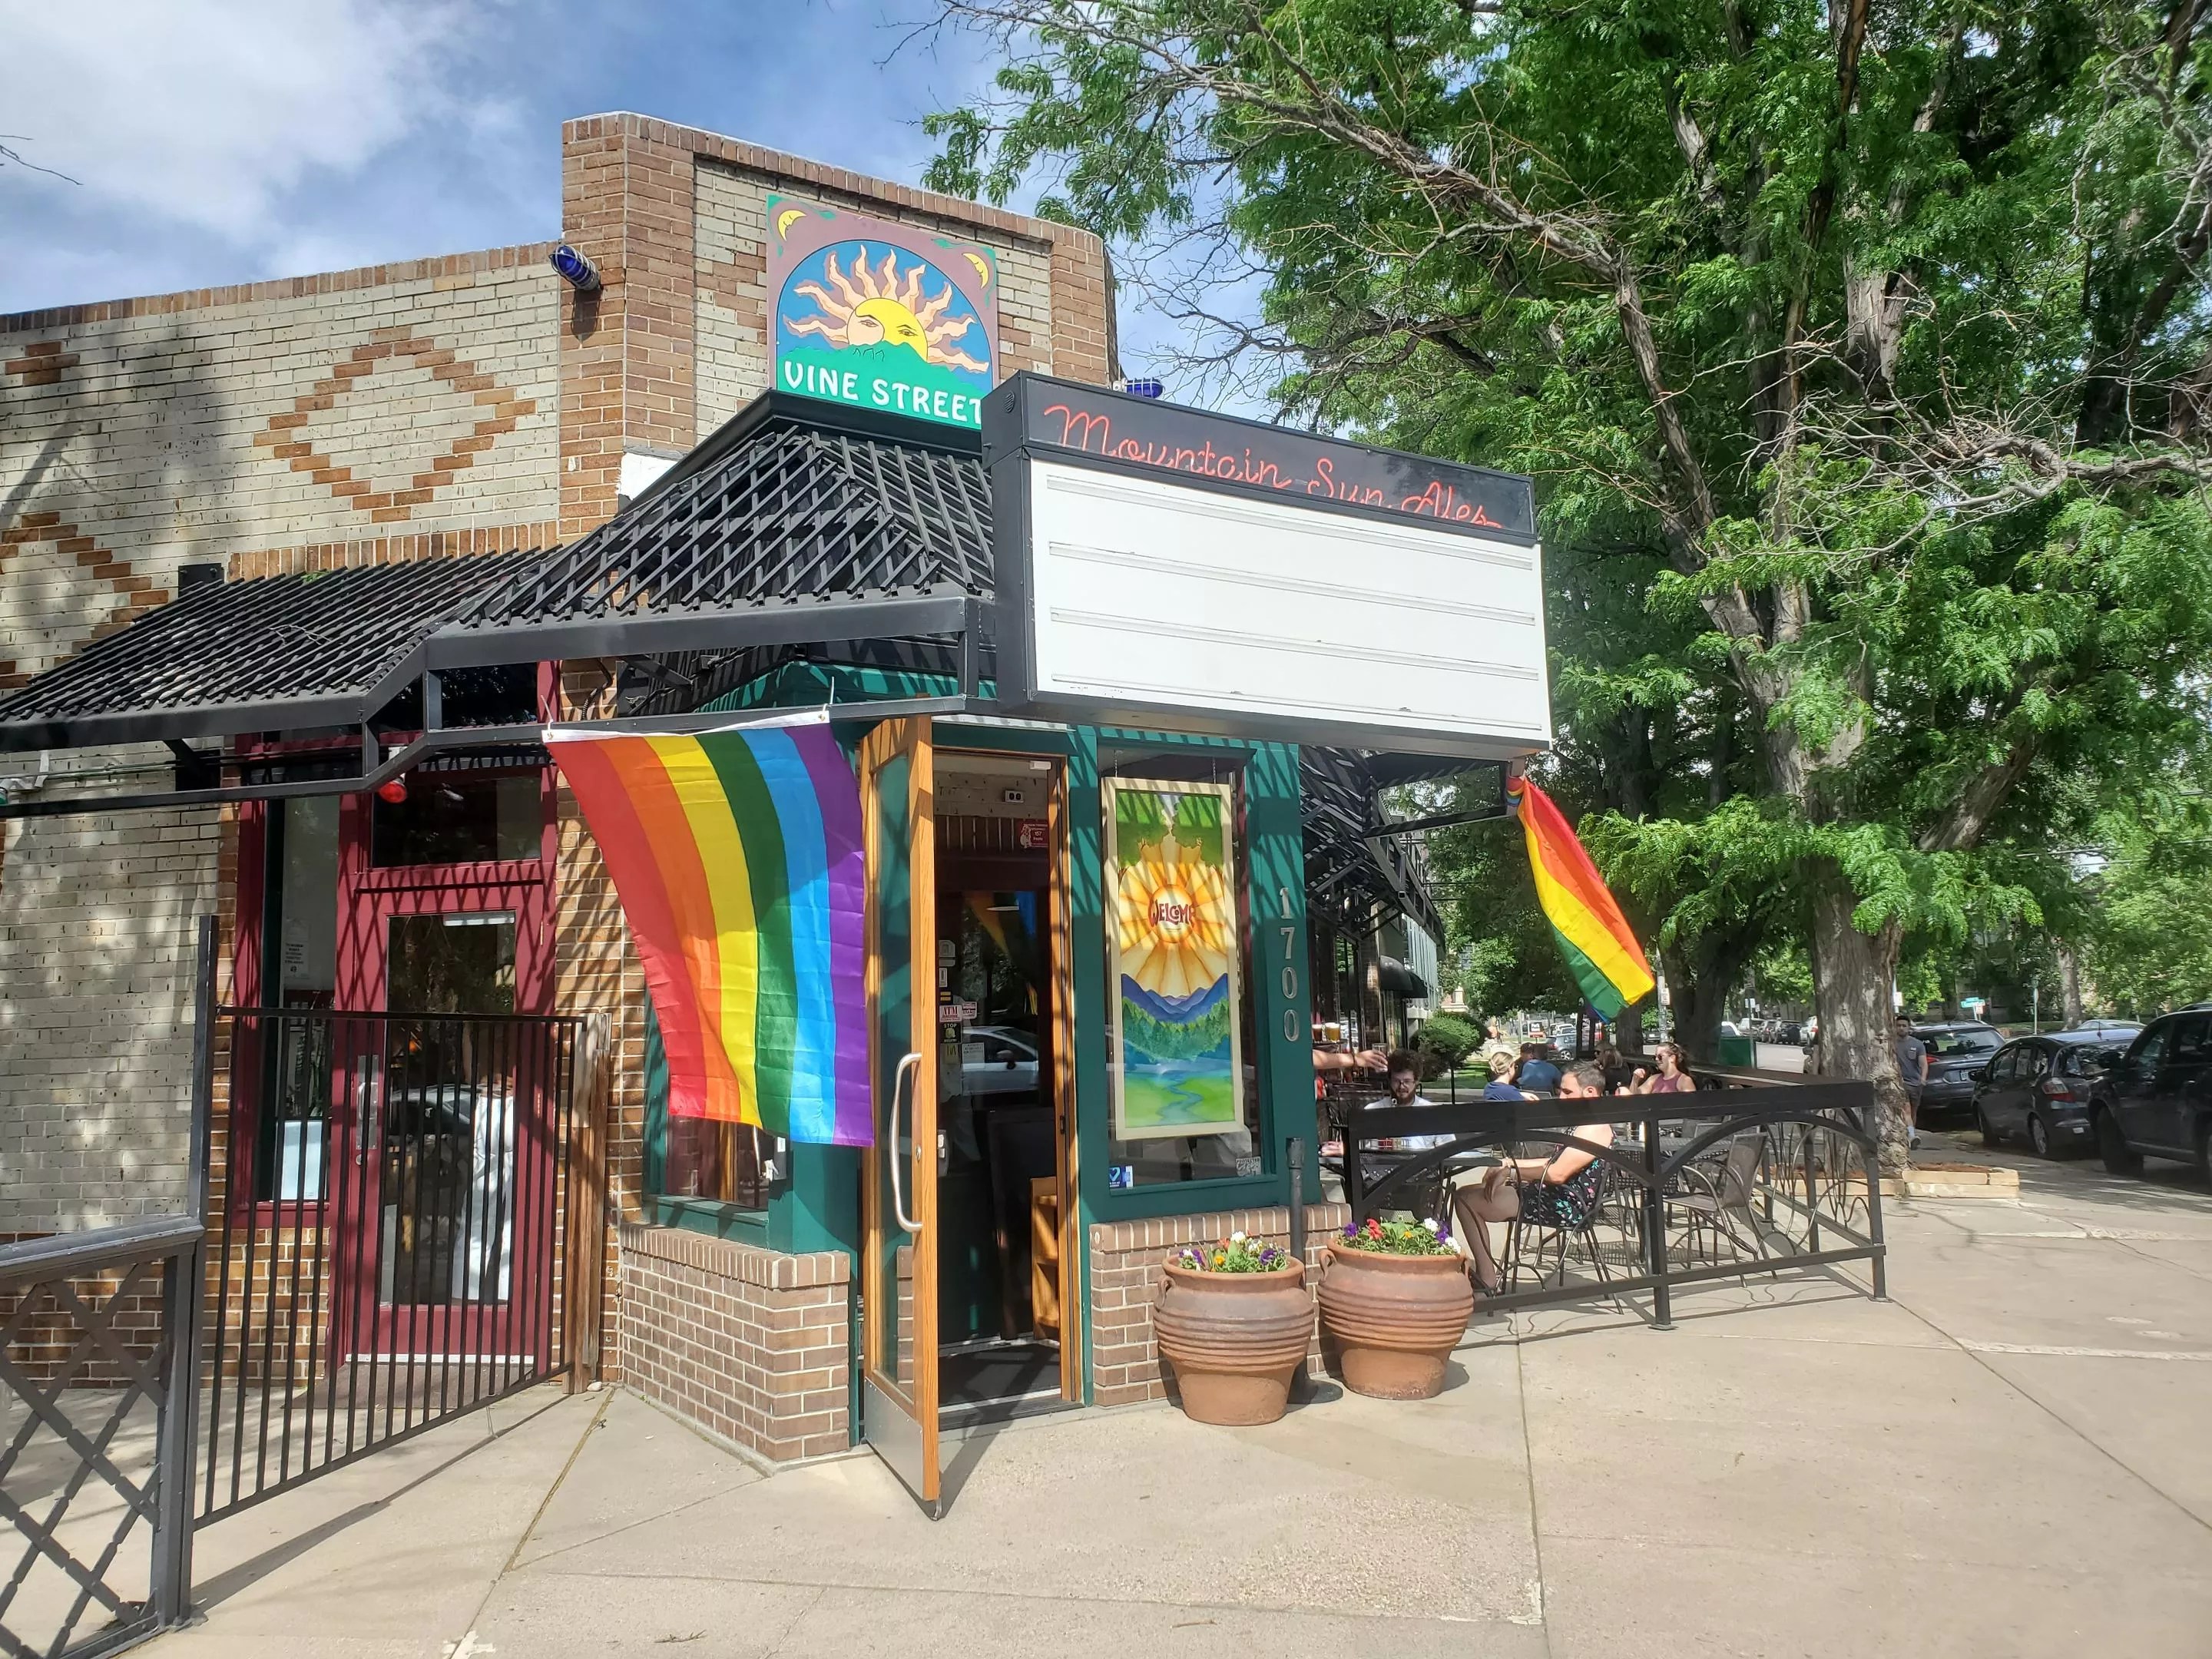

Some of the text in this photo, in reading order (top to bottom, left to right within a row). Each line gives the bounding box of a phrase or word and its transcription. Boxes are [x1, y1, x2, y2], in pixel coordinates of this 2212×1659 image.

[784, 361, 982, 426] VINE STREET
[1043, 404, 1504, 529] Mountain Sun Ales
[1148, 898, 1196, 929] WELCOME
[1280, 887, 1300, 1042] 1700
[942, 1006, 959, 1015] ATM
